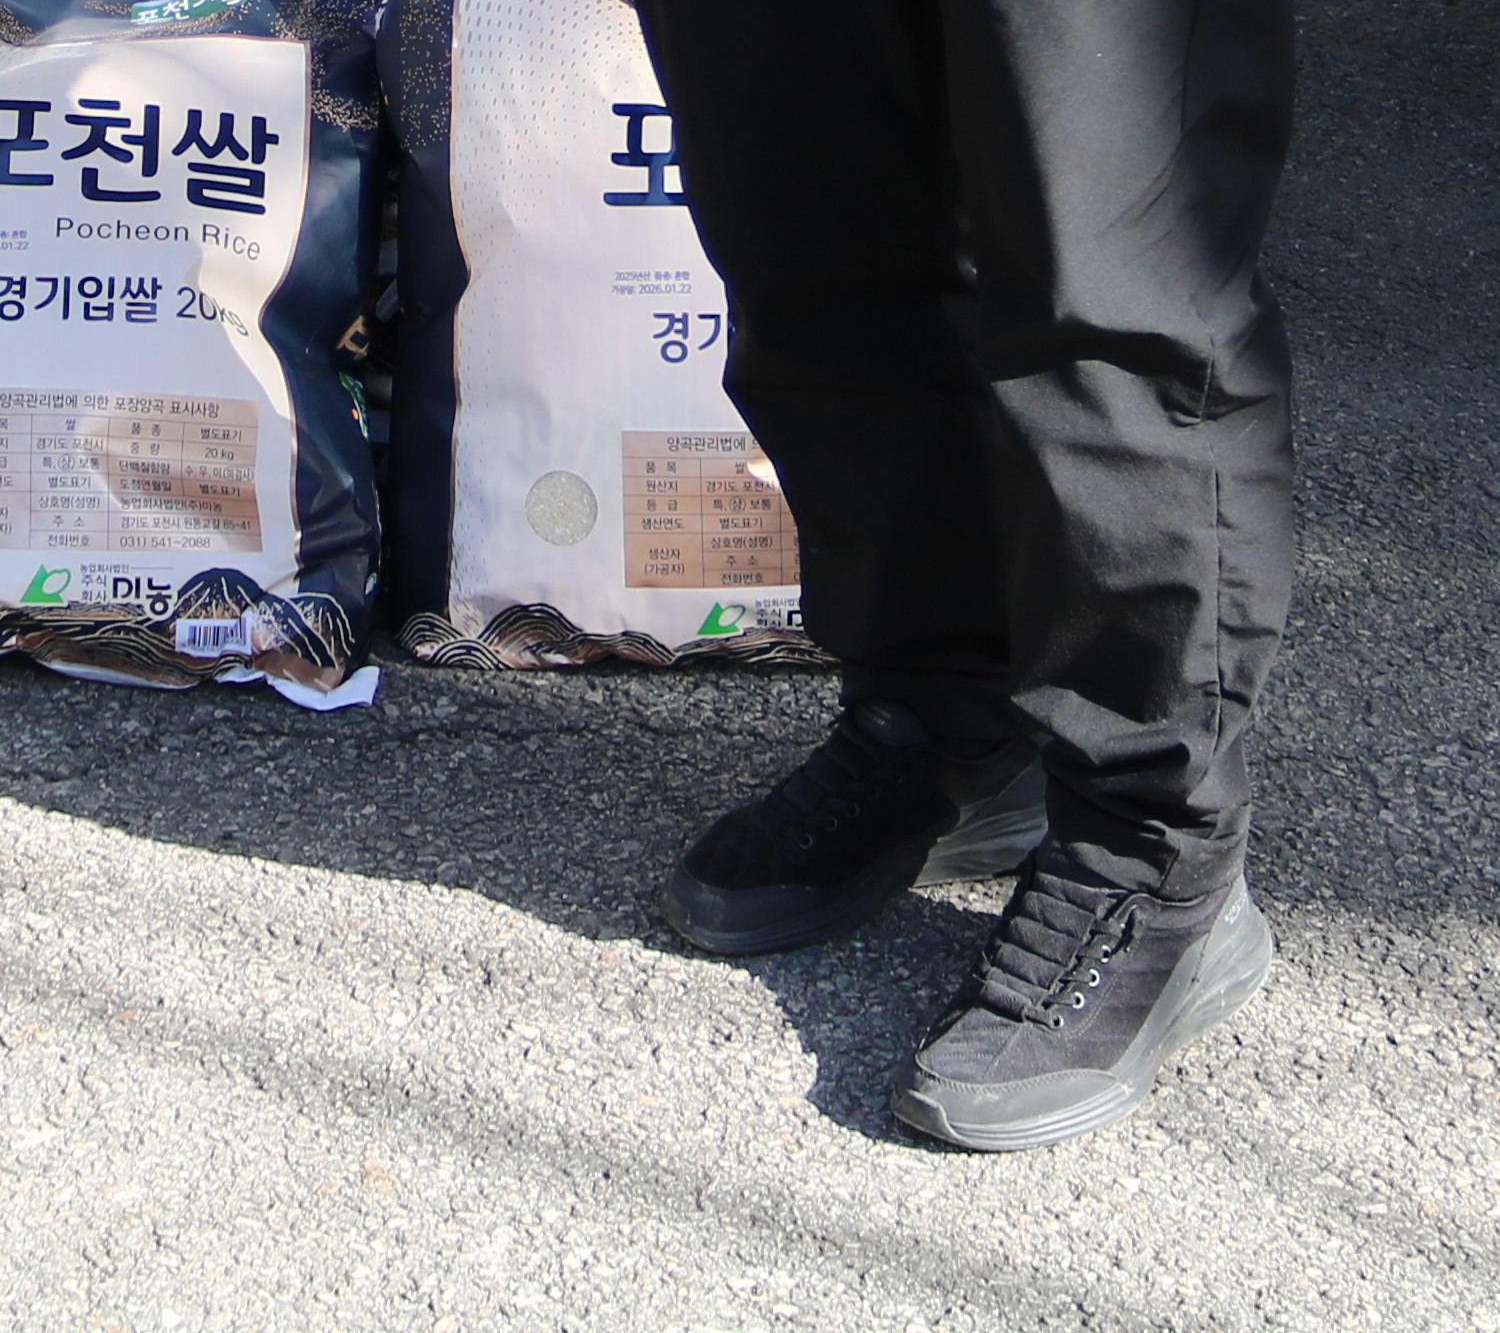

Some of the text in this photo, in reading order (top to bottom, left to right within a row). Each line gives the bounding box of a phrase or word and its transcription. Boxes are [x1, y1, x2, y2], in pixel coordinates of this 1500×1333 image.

[55, 217, 261, 261] Pocheon Rice
[175, 286, 249, 337] 20kg
[0, 393, 220, 418] 양곡관리법에 의한 포장양곡 표시사항
[36, 437, 68, 450] 경기도
[72, 438, 104, 451] 포천시
[204, 447, 217, 459] 20
[221, 448, 234, 461] kg
[667, 437, 746, 452] 양곡관리법에
[734, 461, 745, 474] 쌀
[48, 475, 91, 489] 별도표기
[646, 480, 678, 492] 원산지
[706, 481, 738, 492] 경기도
[38, 495, 101, 509] 상호명(성명)
[121, 516, 148, 529] 경기도
[151, 516, 180, 529] 포천시
[641, 517, 763, 529] 생산연도 별도표기
[47, 535, 90, 548] 전화번호
[119, 536, 147, 549] 031)
[711, 536, 773, 548] 상호명(성명)
[648, 549, 681, 560] 생산자
[80, 563, 129, 574] 농업회사법인
[644, 564, 685, 575] (가공자)
[721, 574, 763, 585] 전화번호
[112, 576, 172, 616] 미농
